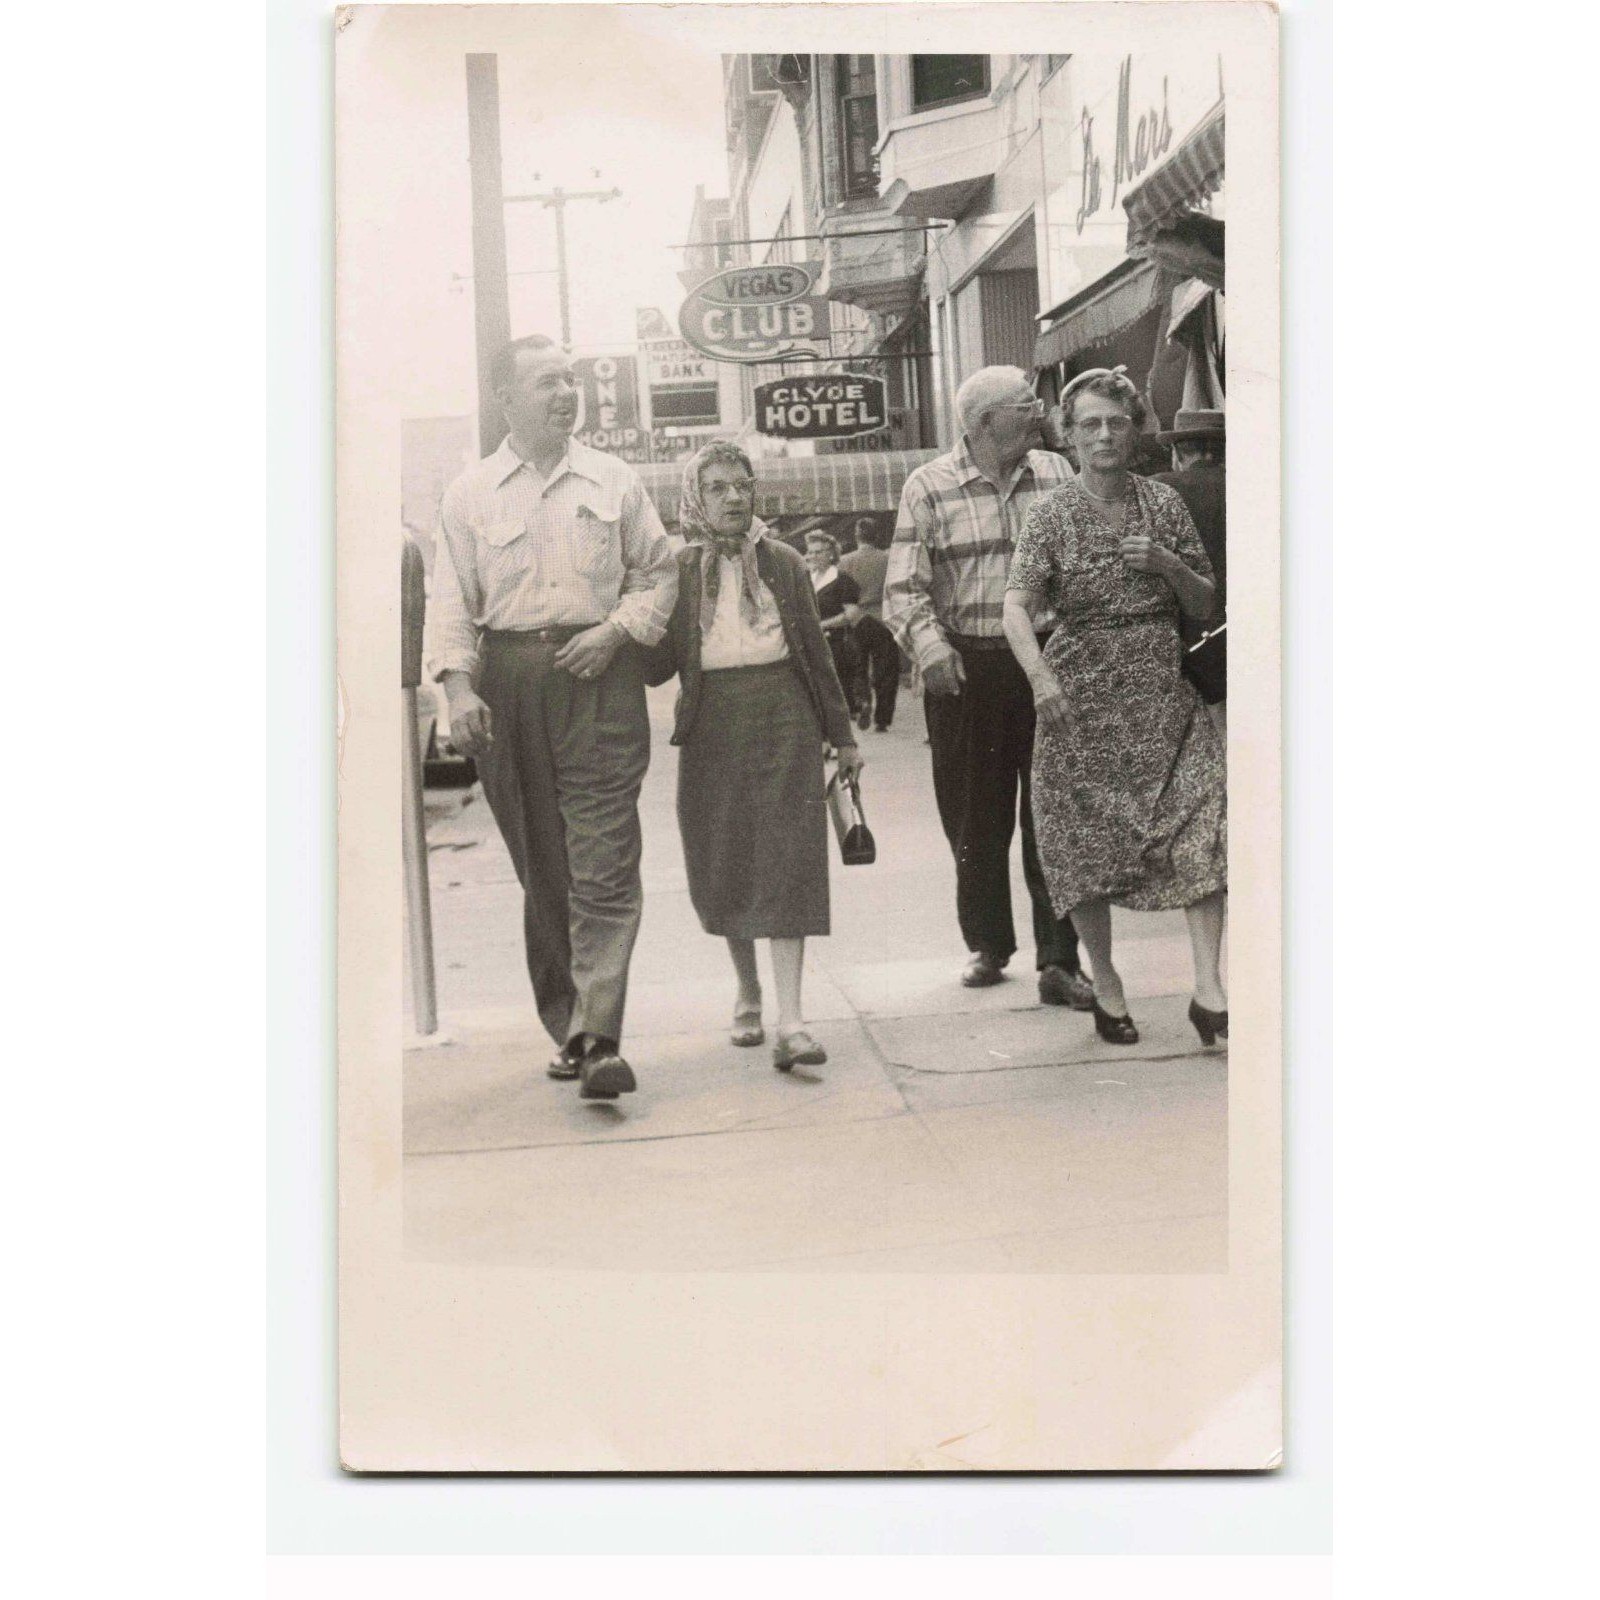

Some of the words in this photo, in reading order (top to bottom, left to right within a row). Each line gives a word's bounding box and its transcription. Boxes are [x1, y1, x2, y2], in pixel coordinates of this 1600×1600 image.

[724, 271, 793, 299] VEGAS
[701, 302, 814, 341] CLUB
[660, 362, 705, 379] BANK
[593, 358, 619, 429] ONE
[772, 384, 865, 403] CLYDE
[765, 401, 879, 429] HOTEL
[580, 428, 638, 448] HOUR
[833, 434, 892, 451] UNION
